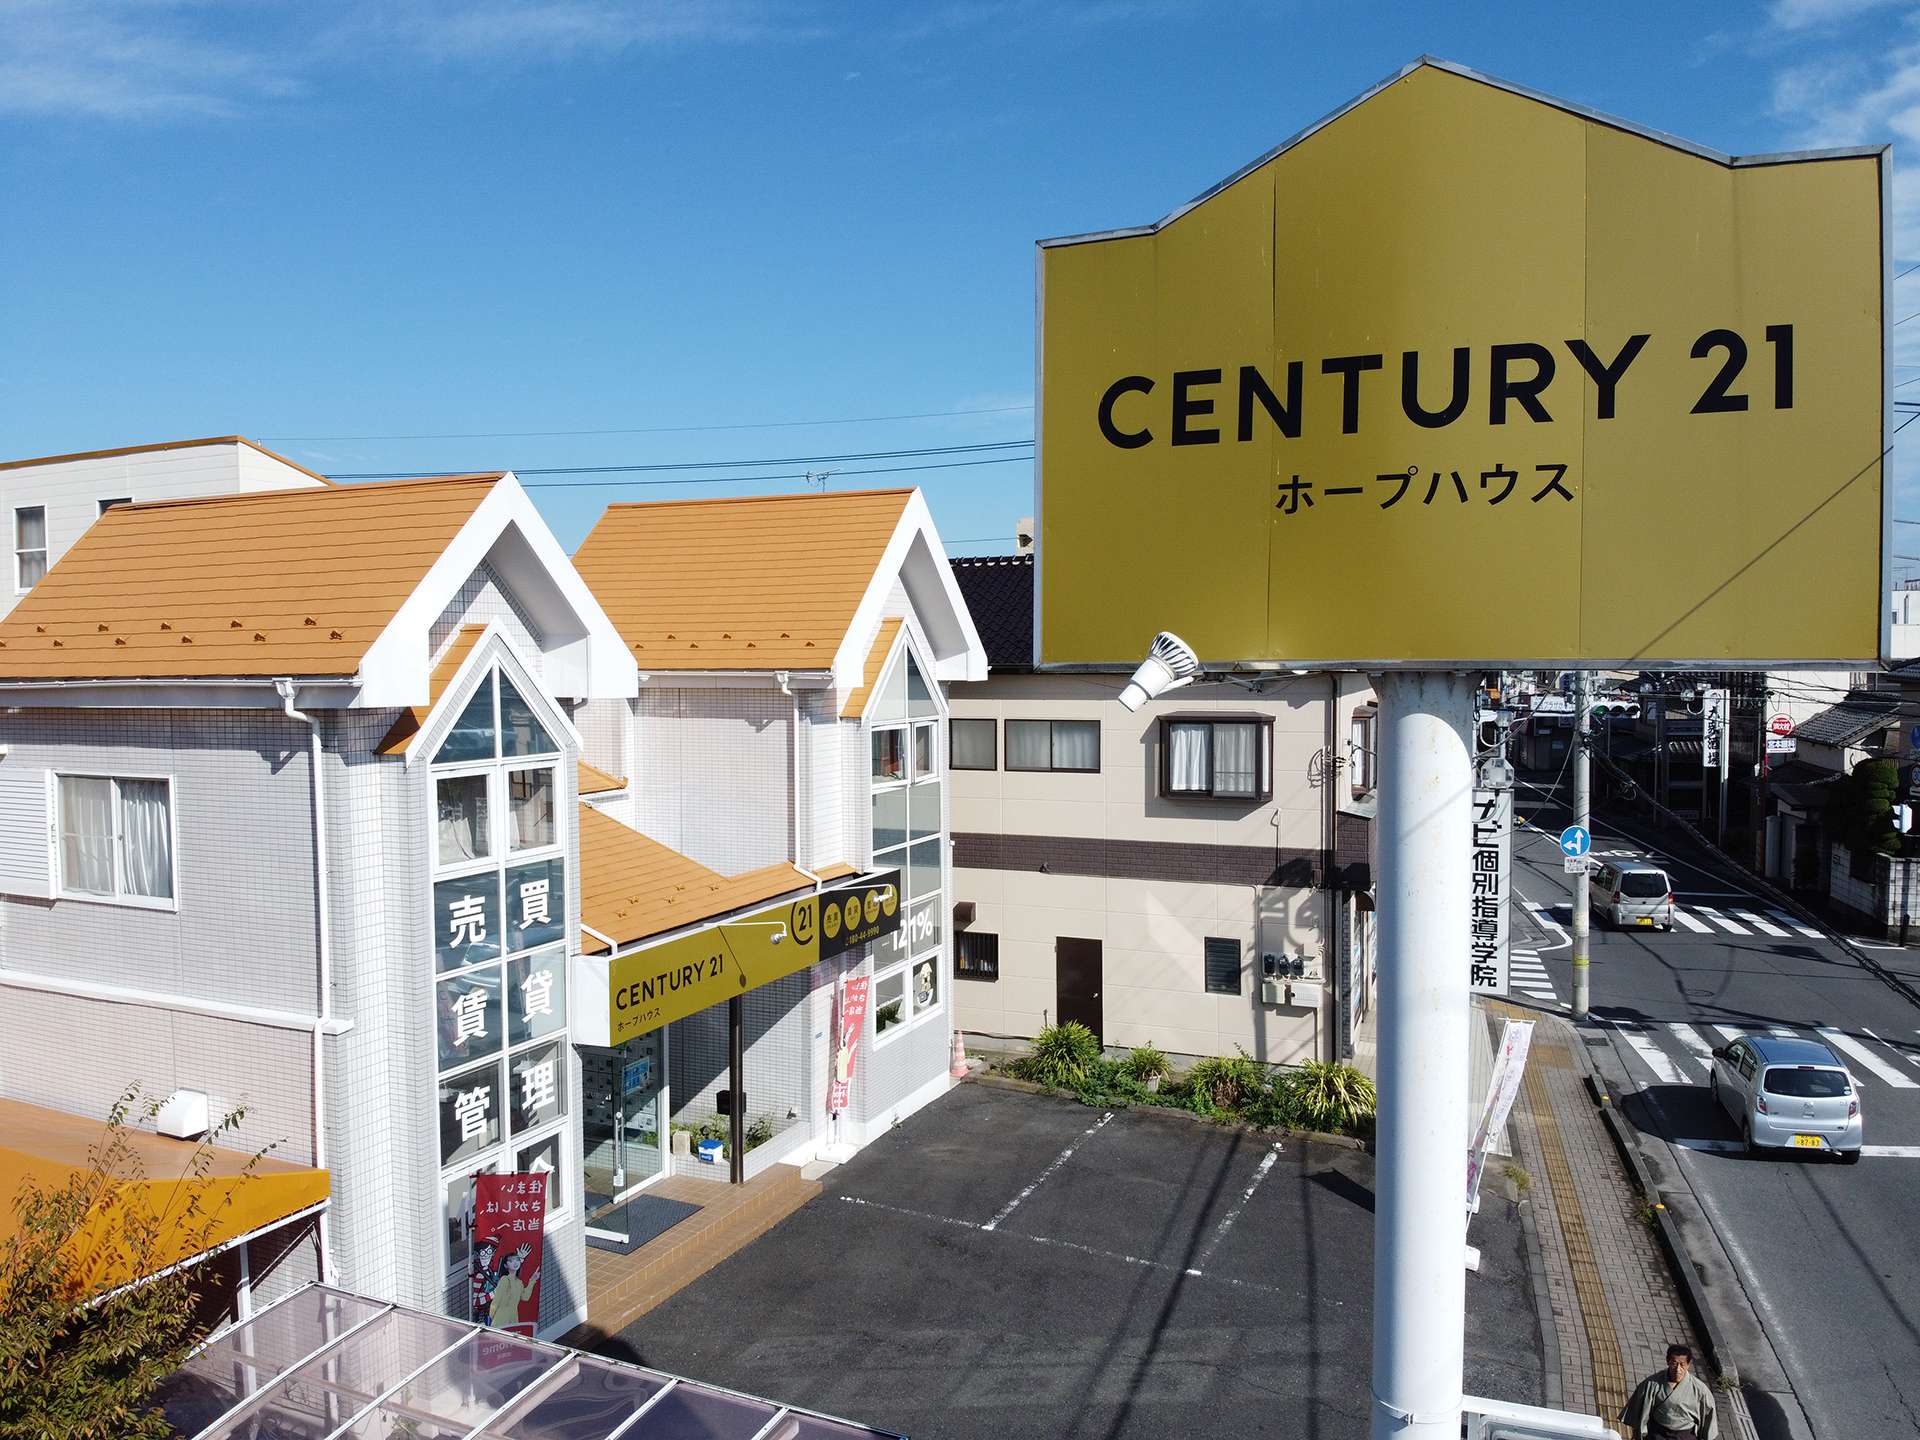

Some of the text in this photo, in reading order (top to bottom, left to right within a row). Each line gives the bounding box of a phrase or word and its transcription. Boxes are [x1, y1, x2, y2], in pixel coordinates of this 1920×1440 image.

[1097, 324, 1794, 449] CENTURY 21
[1275, 463, 1574, 515] ホープハウス
[449, 878, 550, 949] 売買
[1471, 799, 1502, 988] ナビ個別指導学院
[452, 969, 553, 1048] 賃貸
[616, 954, 724, 1010] CENTURY 21
[617, 1007, 661, 1032] ホープハウス
[454, 1058, 556, 1143] 管理
